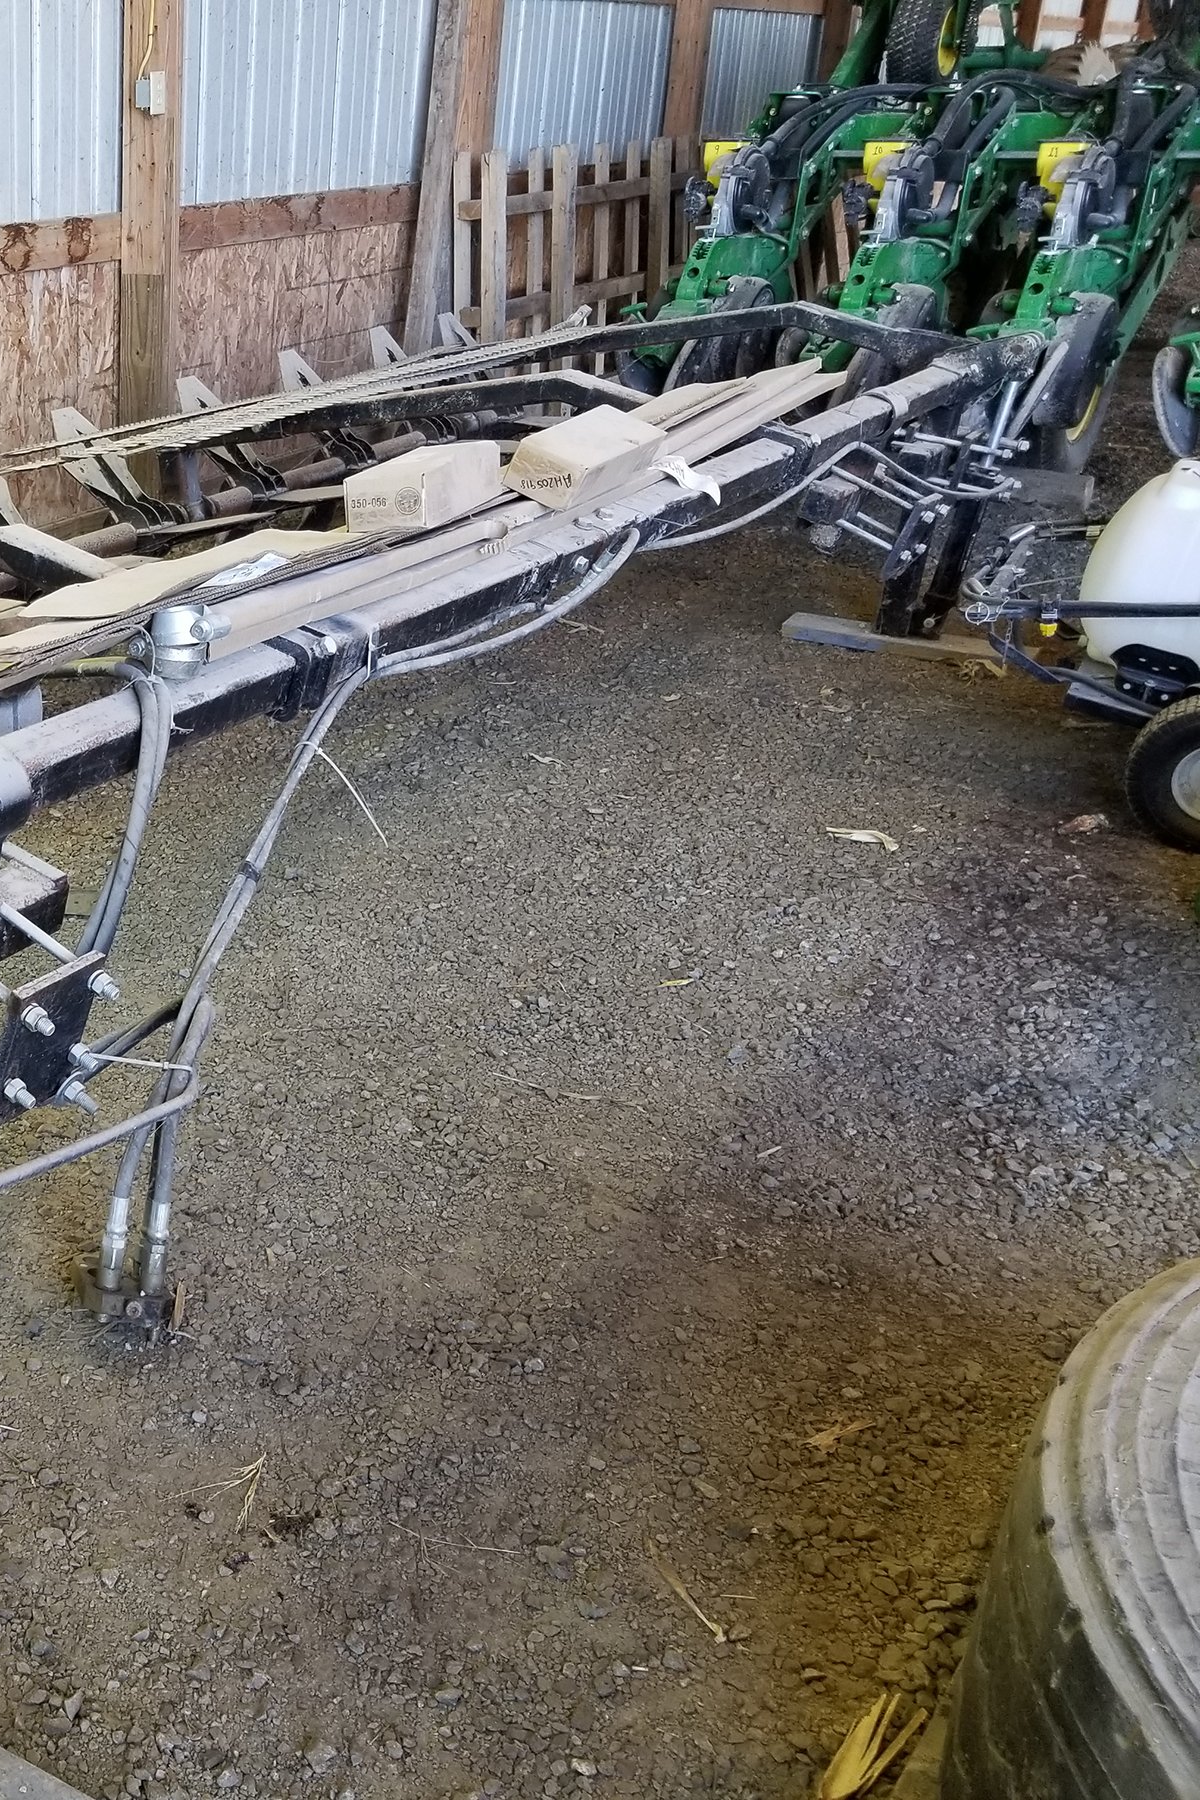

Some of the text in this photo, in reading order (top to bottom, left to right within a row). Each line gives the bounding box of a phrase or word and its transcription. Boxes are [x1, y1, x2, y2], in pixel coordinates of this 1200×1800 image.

[714, 144, 720, 155] 9
[872, 145, 883, 156] 10
[1047, 146, 1059, 158] 11
[351, 497, 387, 509] 350-056
